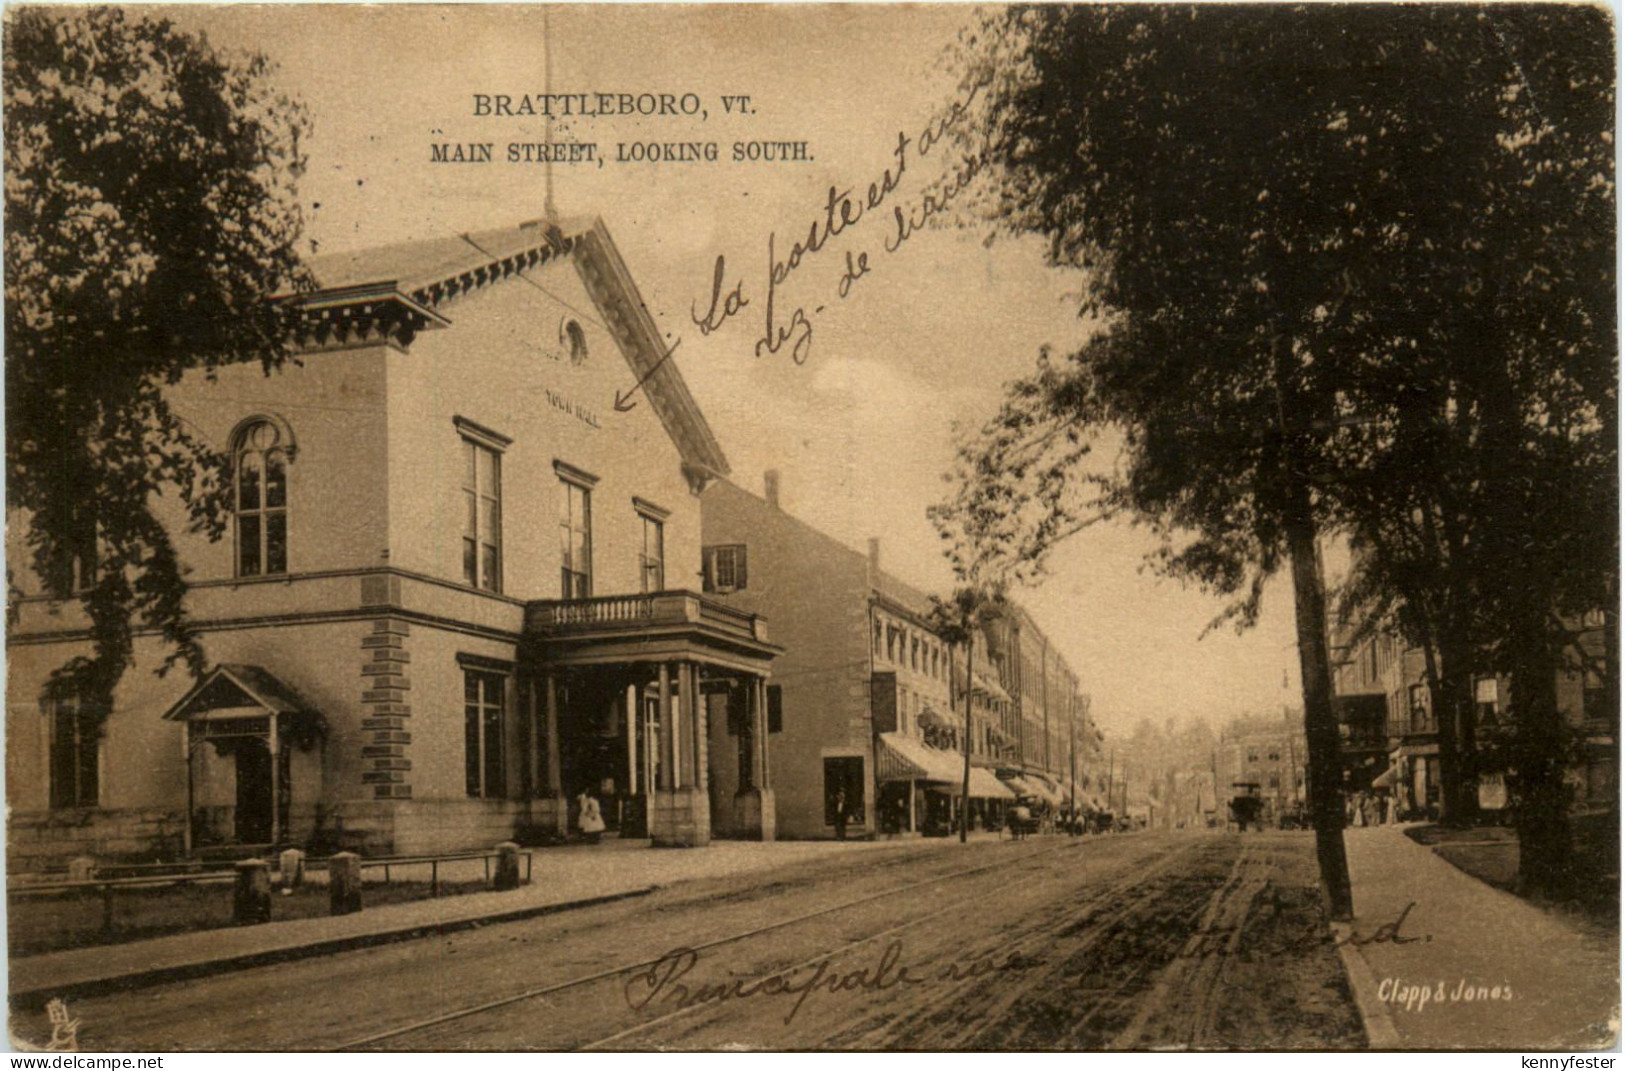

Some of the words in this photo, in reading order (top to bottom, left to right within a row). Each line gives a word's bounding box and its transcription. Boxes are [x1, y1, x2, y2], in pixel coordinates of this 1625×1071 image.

[691, 254, 749, 336] La
[766, 186, 863, 346] poste
[867, 131, 911, 210] est
